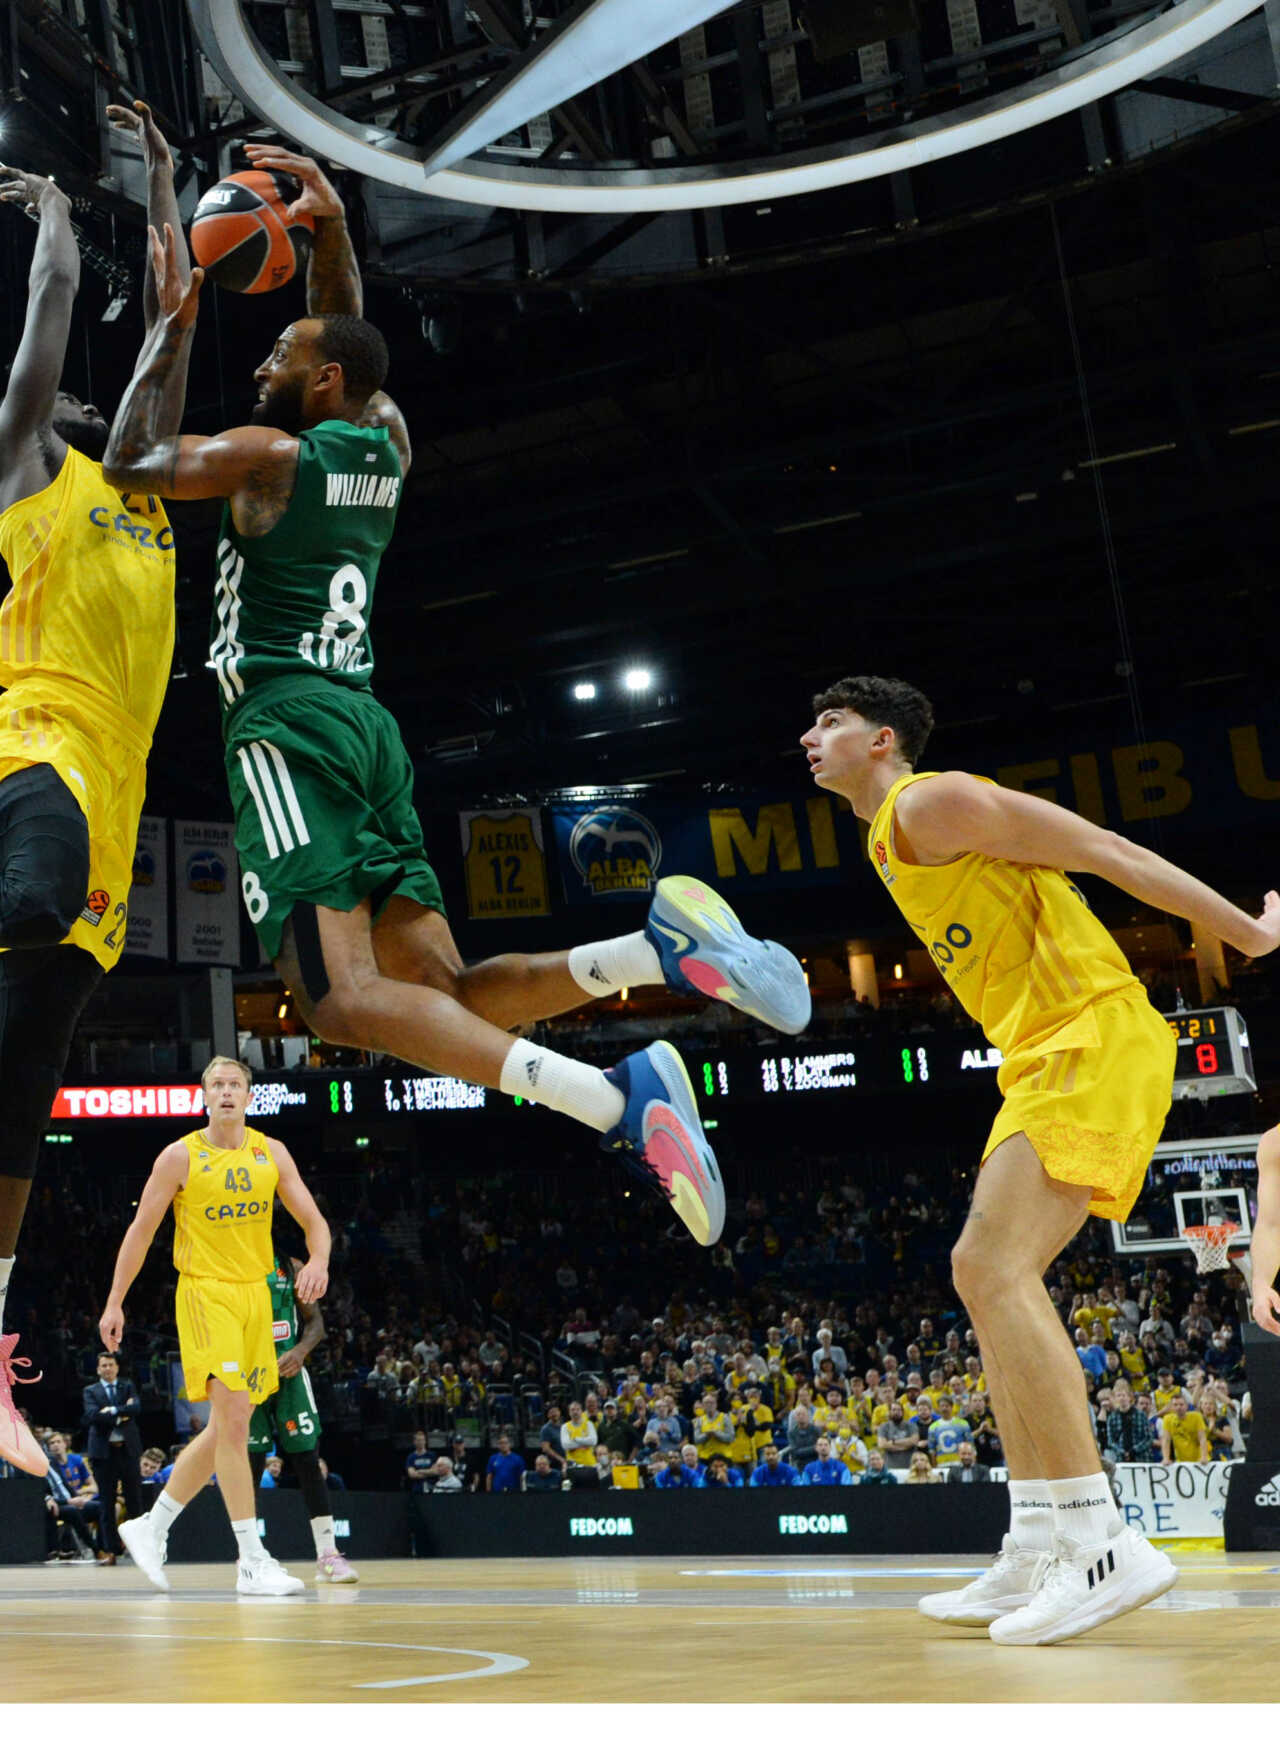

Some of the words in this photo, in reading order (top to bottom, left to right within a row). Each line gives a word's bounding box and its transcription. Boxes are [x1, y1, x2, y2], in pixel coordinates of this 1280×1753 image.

[326, 473, 399, 508] WILLIAMS
[321, 564, 367, 647] 8
[479, 833, 529, 852] ALEXIS
[490, 855, 523, 894] 12
[588, 857, 651, 881] ALBA
[595, 874, 648, 890] BERLIN
[242, 872, 269, 924] 8
[1196, 1043, 1219, 1075] 8
[225, 1167, 252, 1193] 43
[298, 1411, 315, 1435] 5
[1057, 1497, 1107, 1510] adidas
[570, 1518, 633, 1536] FEDCOM
[779, 1515, 847, 1534] FEDCOM
